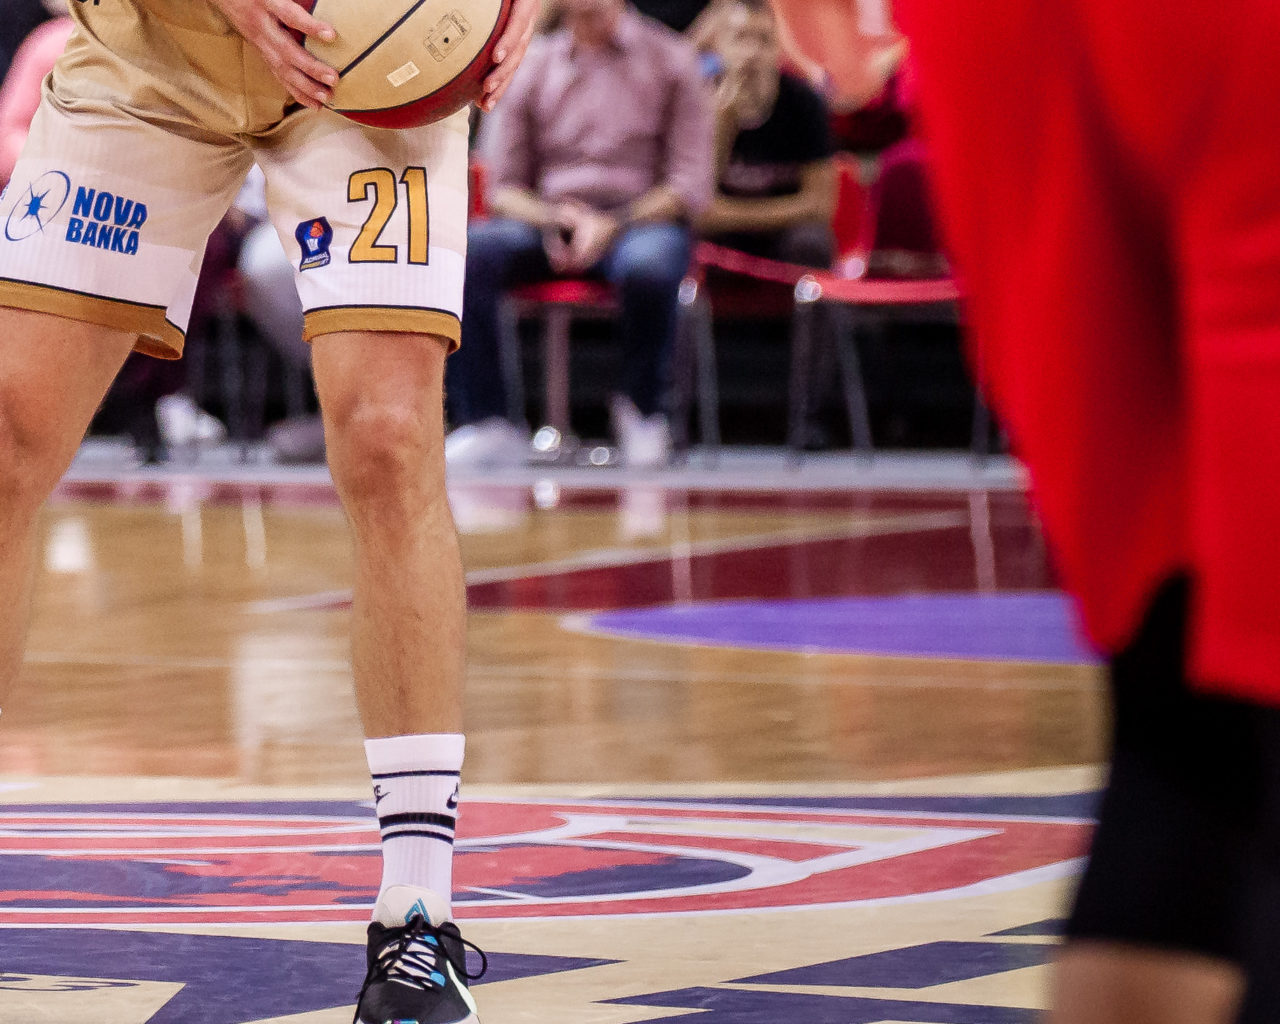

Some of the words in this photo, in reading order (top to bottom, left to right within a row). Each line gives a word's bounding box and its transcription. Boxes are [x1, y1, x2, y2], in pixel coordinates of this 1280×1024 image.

[72, 186, 148, 230] NOVA
[346, 165, 430, 267] 21
[65, 217, 140, 256] BANKA
